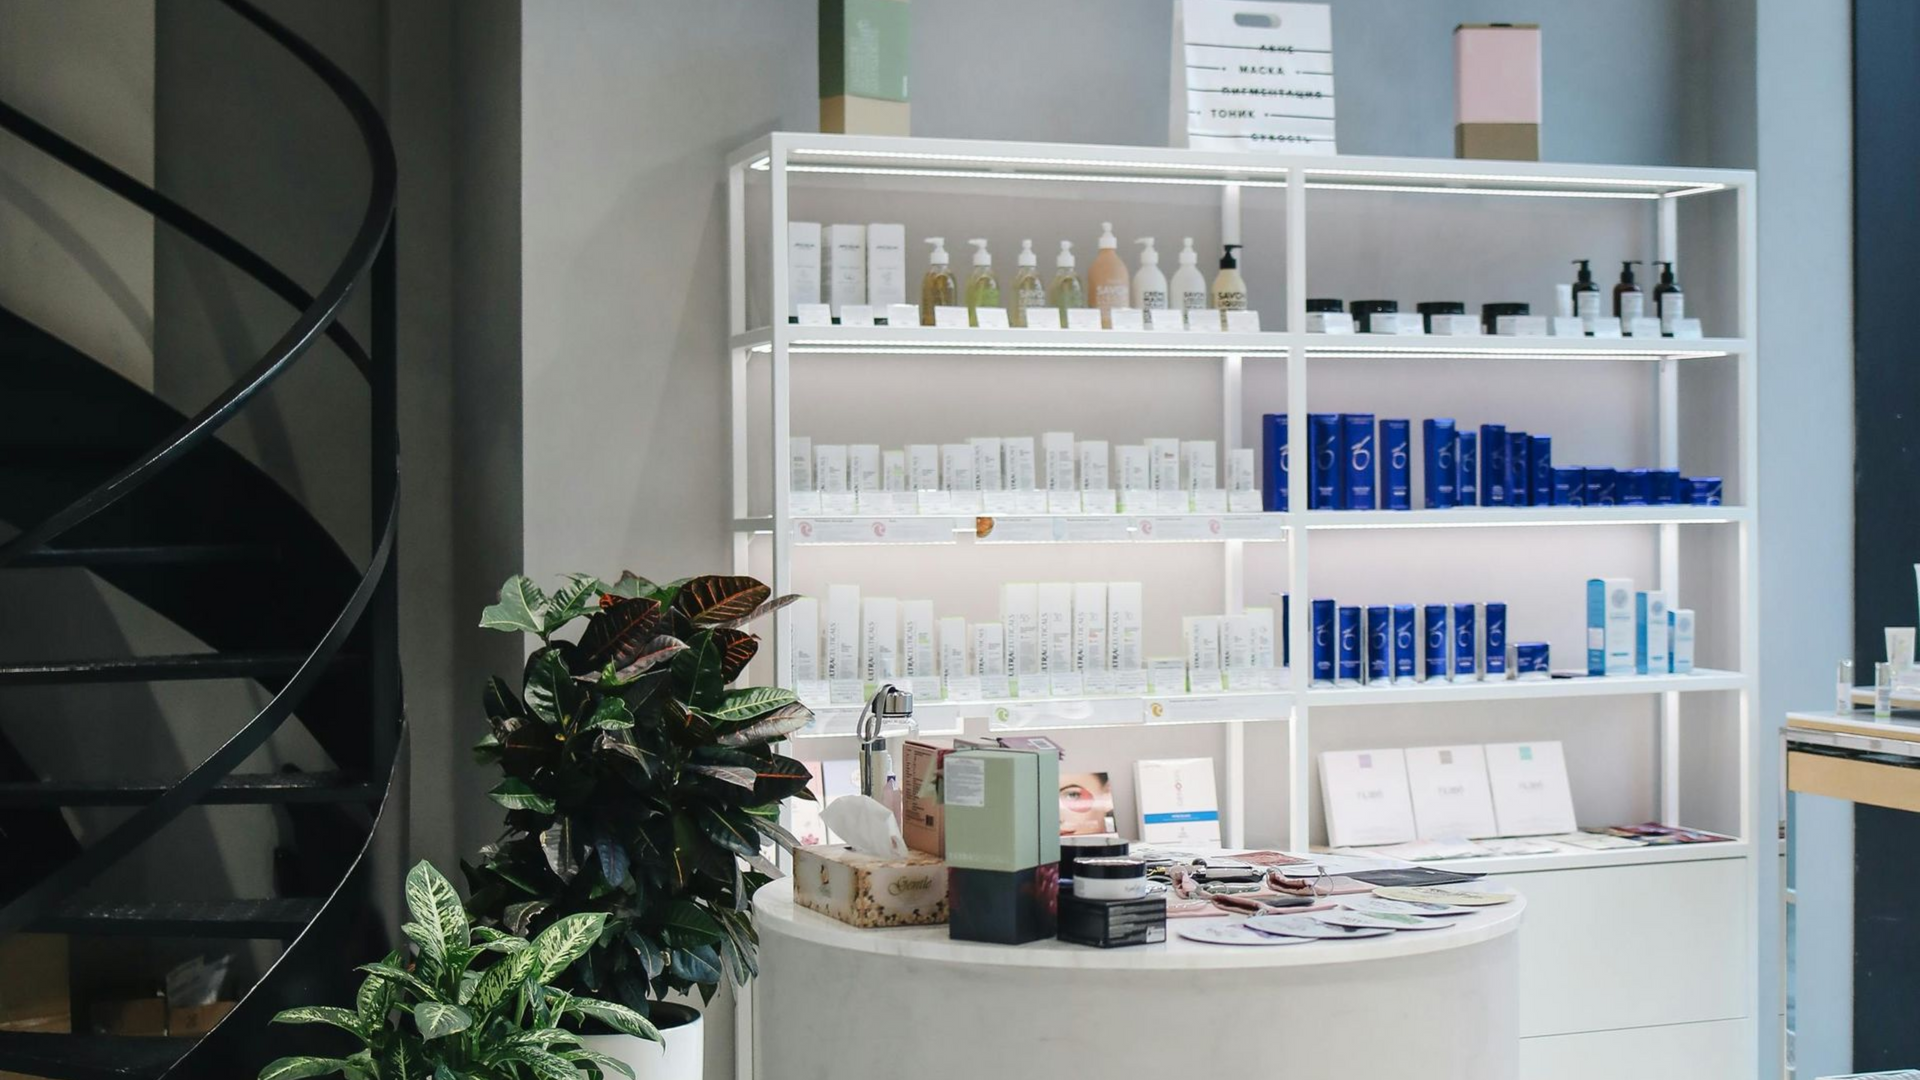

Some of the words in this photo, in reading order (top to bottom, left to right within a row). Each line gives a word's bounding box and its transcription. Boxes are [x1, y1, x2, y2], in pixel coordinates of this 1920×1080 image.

[1239, 65, 1286, 75] МАСКА
[1211, 109, 1256, 118] ТОНИК
[1041, 612, 1049, 672] LTRACEUTICALS
[888, 875, 932, 896] Gentle
